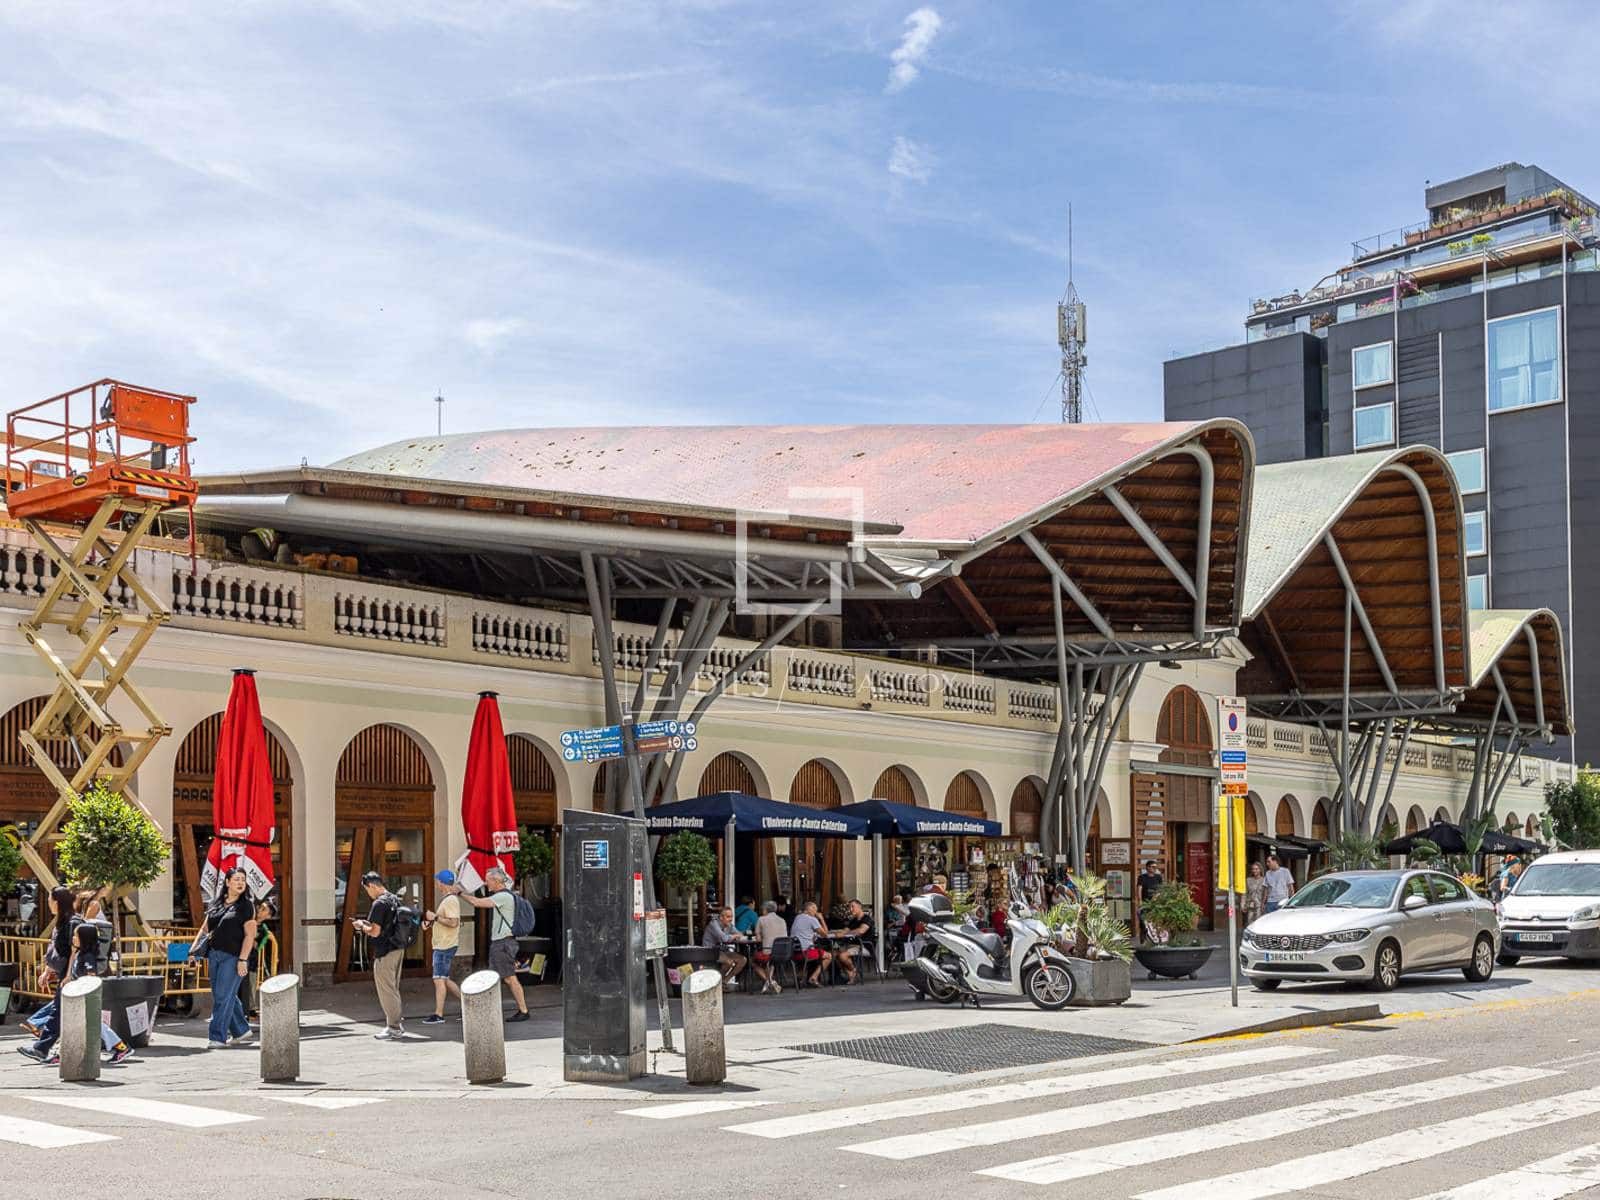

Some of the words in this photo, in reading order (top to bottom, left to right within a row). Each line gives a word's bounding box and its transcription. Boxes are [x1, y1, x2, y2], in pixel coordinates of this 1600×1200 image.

[651, 816, 673, 828] Santa
[673, 816, 704, 828] Caterina
[793, 817, 802, 828] de
[802, 817, 821, 830] Santa
[821, 819, 848, 832] Caterina
[941, 822, 949, 832] de
[949, 822, 964, 832] Santa
[964, 822, 985, 833] Caterina
